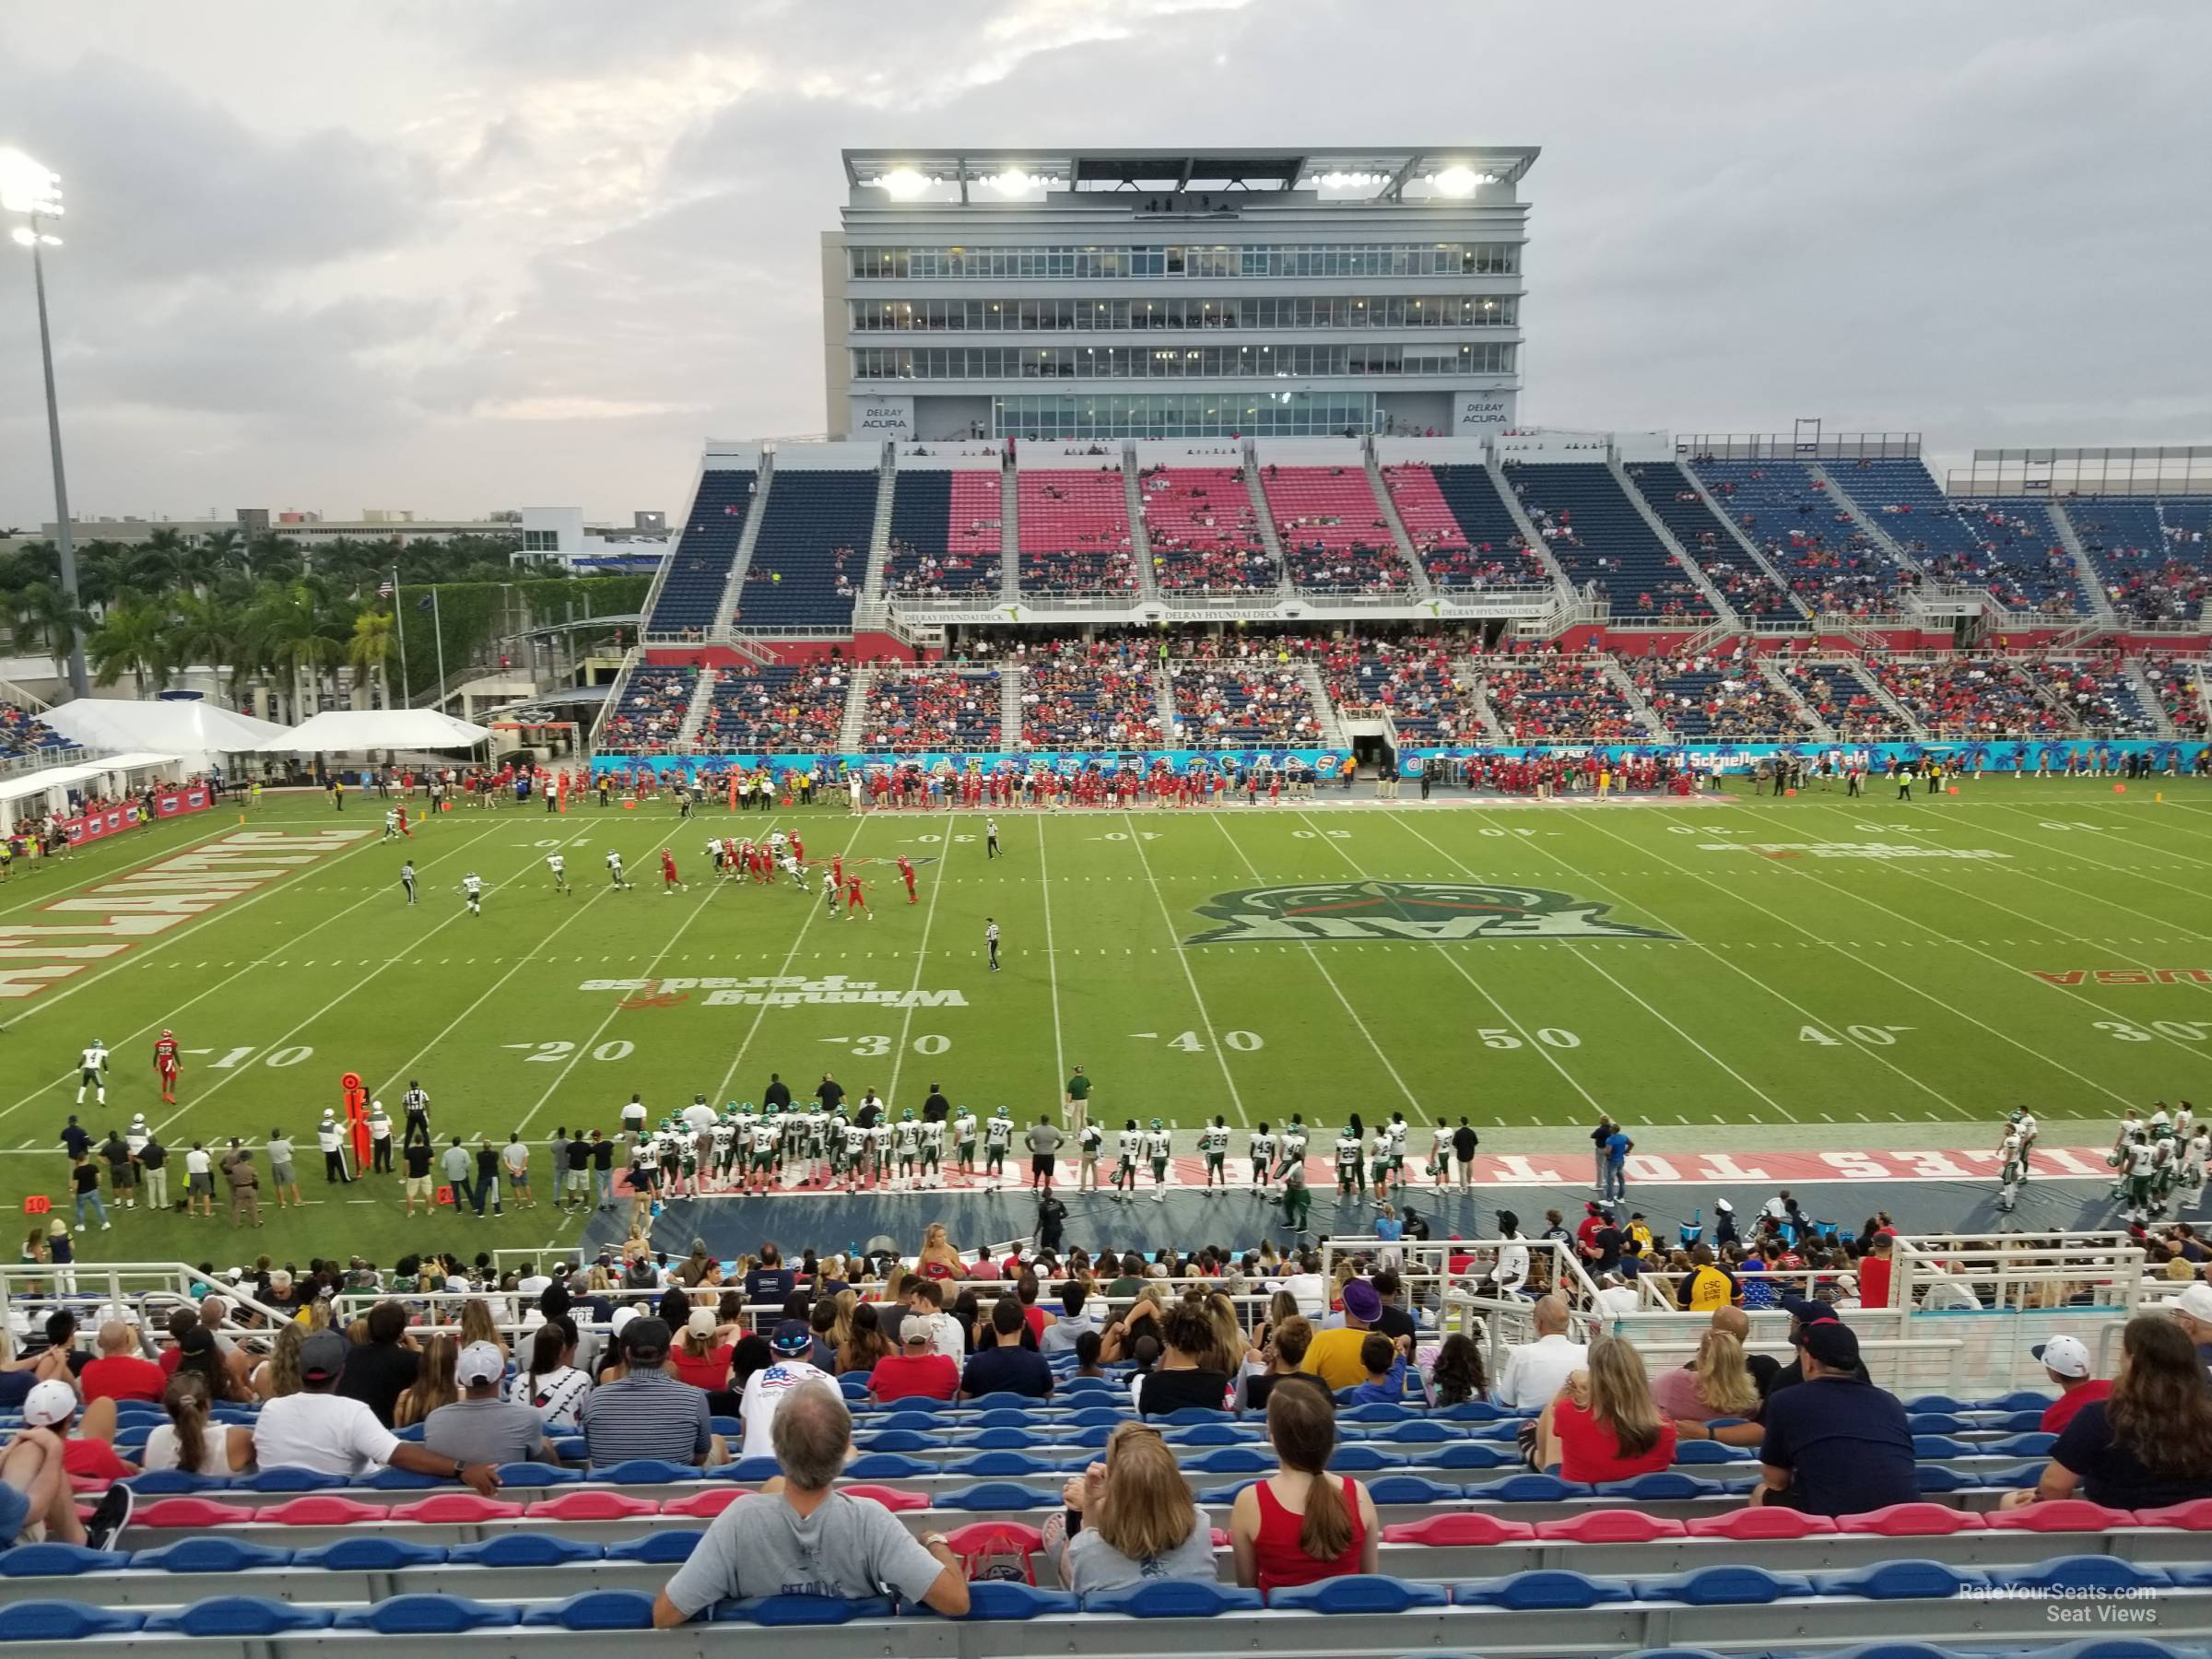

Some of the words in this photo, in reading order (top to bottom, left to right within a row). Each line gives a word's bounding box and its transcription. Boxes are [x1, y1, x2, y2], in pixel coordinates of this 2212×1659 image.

[866, 408, 905, 418] DELRAY
[1466, 404, 1505, 412] DELRAY
[862, 419, 908, 429] ACURA
[1462, 415, 1508, 423] ACURA
[904, 613, 938, 621] DELRAY
[939, 613, 980, 621] HYUNDAI
[980, 613, 1005, 621] DECK
[1165, 611, 1203, 619] DELRAY
[1205, 610, 1251, 618] HYUNDAI
[1253, 610, 1280, 618] DECK
[918, 834, 977, 842] 30
[1104, 832, 1164, 841] 40
[1291, 830, 1353, 839] 50
[1478, 828, 1537, 837] 40
[1208, 909, 1650, 940] FAU
[2030, 970, 2212, 986] USA
[846, 982, 878, 990] in
[701, 990, 970, 1007] Winning
[1799, 1025, 1899, 1046] 40
[2091, 1020, 2208, 1041] 30
[851, 1034, 952, 1056] 30
[1167, 1030, 1265, 1052] 40
[1477, 1027, 1582, 1049] 50
[206, 1046, 314, 1068] 10
[524, 1041, 636, 1063] 20
[993, 1124, 1007, 1137] 37
[758, 1133, 771, 1147] 54
[849, 1133, 865, 1147] 93
[1130, 1137, 1138, 1150] 9
[1156, 1138, 1167, 1153] 14
[1257, 1141, 1272, 1154] 43
[641, 1149, 654, 1163] 84
[2140, 1152, 2149, 1166] 7
[1619, 1153, 1771, 1182] TO
[27, 1197, 45, 1211] 10
[1703, 1280, 1721, 1289] CSC
